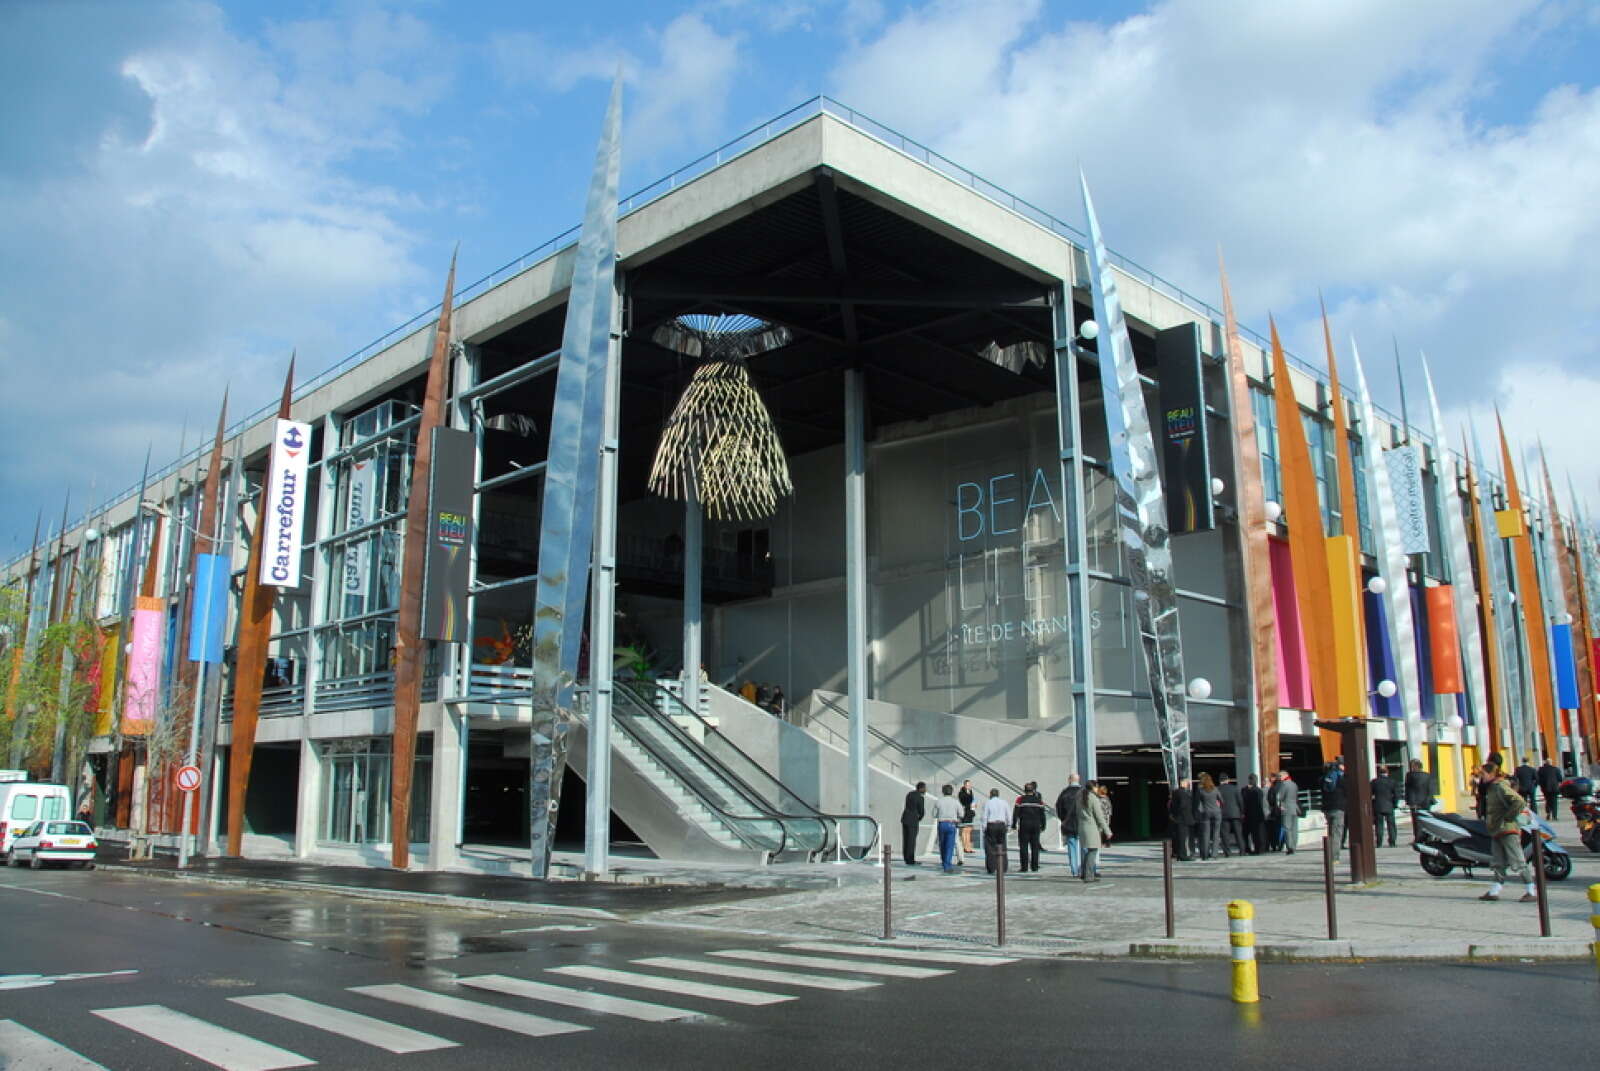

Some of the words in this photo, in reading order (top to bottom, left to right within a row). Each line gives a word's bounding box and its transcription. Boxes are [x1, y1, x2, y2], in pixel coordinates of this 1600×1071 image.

[271, 469, 297, 581] Carrefour
[440, 512, 465, 526] BEAU
[991, 622, 1014, 642] DE
[1020, 611, 1102, 638] NANS
